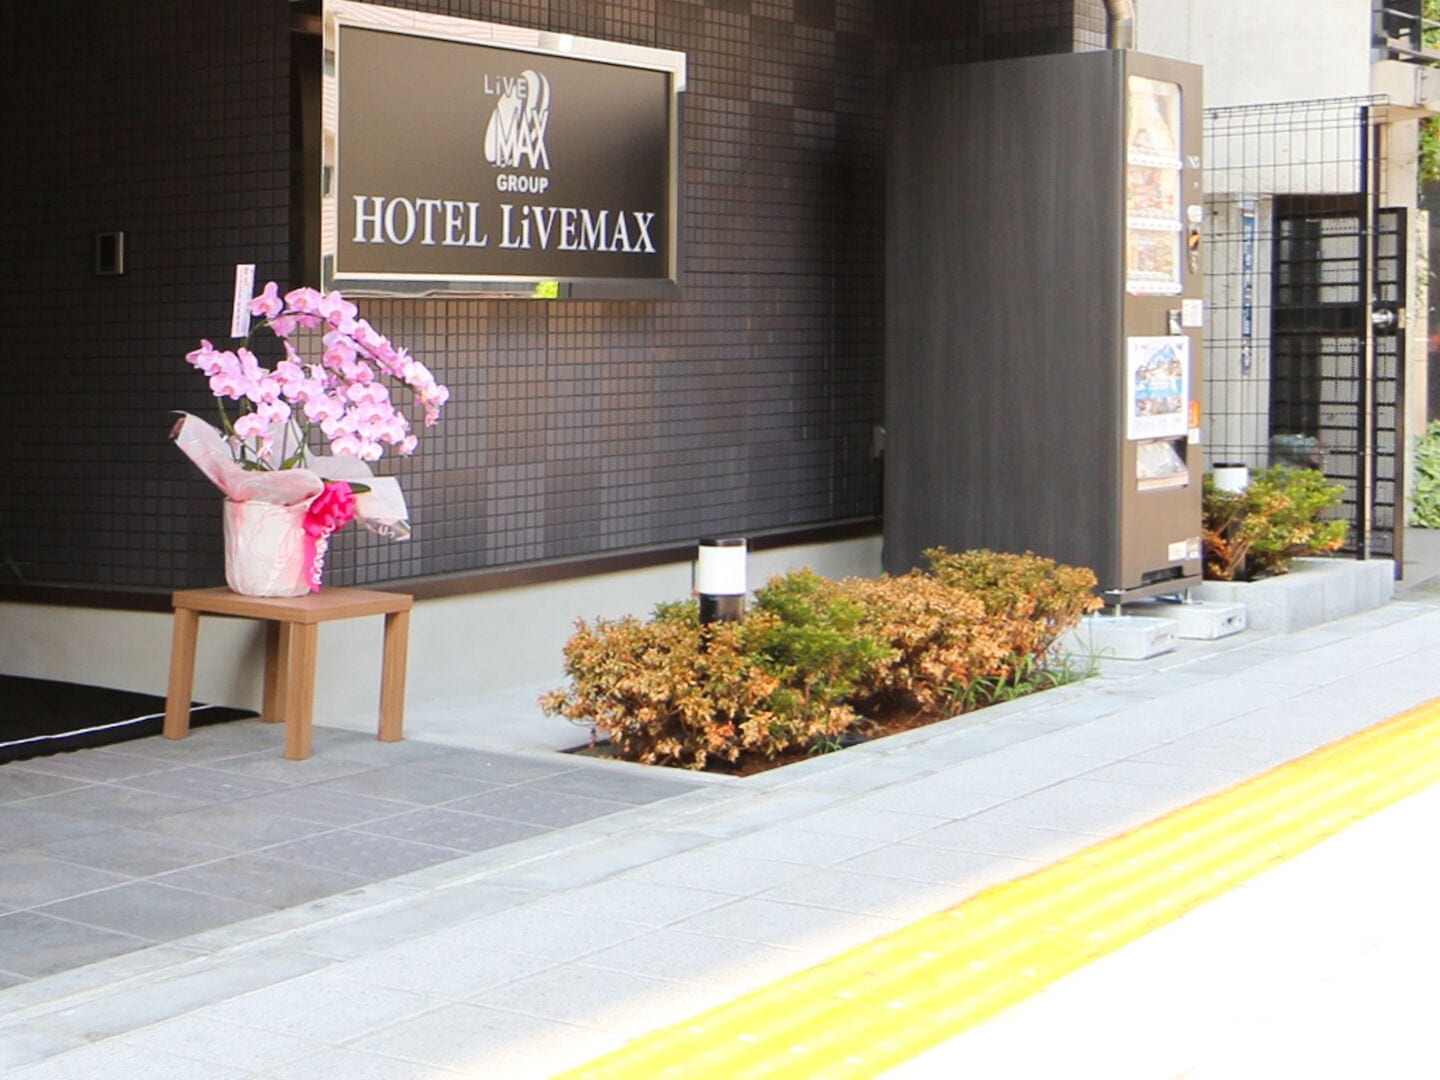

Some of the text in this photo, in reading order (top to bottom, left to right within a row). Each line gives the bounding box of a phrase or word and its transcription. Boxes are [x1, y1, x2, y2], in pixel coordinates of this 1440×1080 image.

[496, 173, 550, 194] GROUP
[351, 194, 656, 254] HOTEL LiVEMAX
